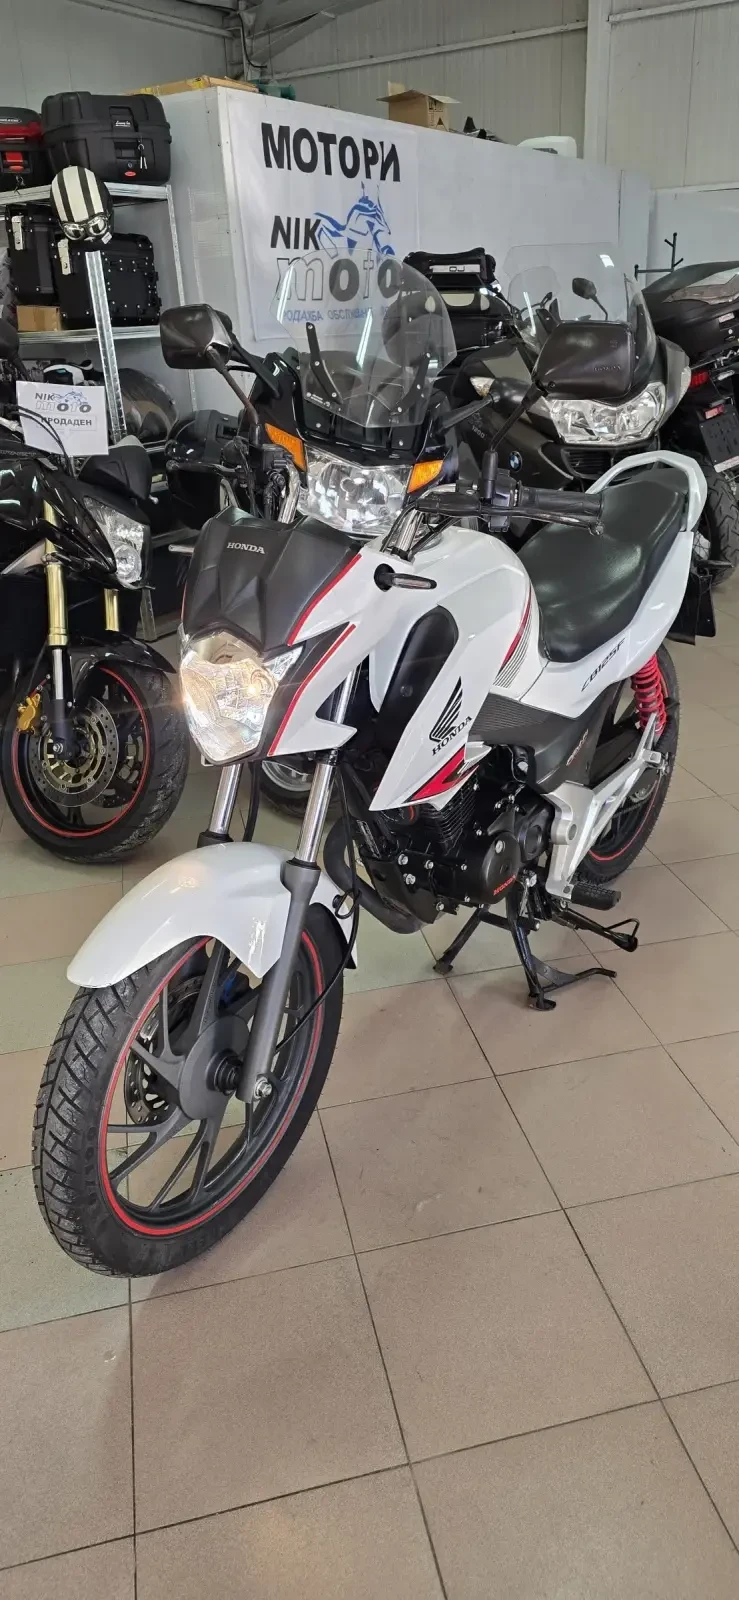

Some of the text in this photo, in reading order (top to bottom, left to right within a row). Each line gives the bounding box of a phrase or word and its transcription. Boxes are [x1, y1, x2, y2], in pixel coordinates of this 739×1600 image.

[261, 122, 401, 182] МОТОРИ
[270, 215, 321, 250] NIK
[34, 392, 54, 401] NIK
[226, 541, 266, 555] HONDA
[432, 715, 473, 756] HONDA
